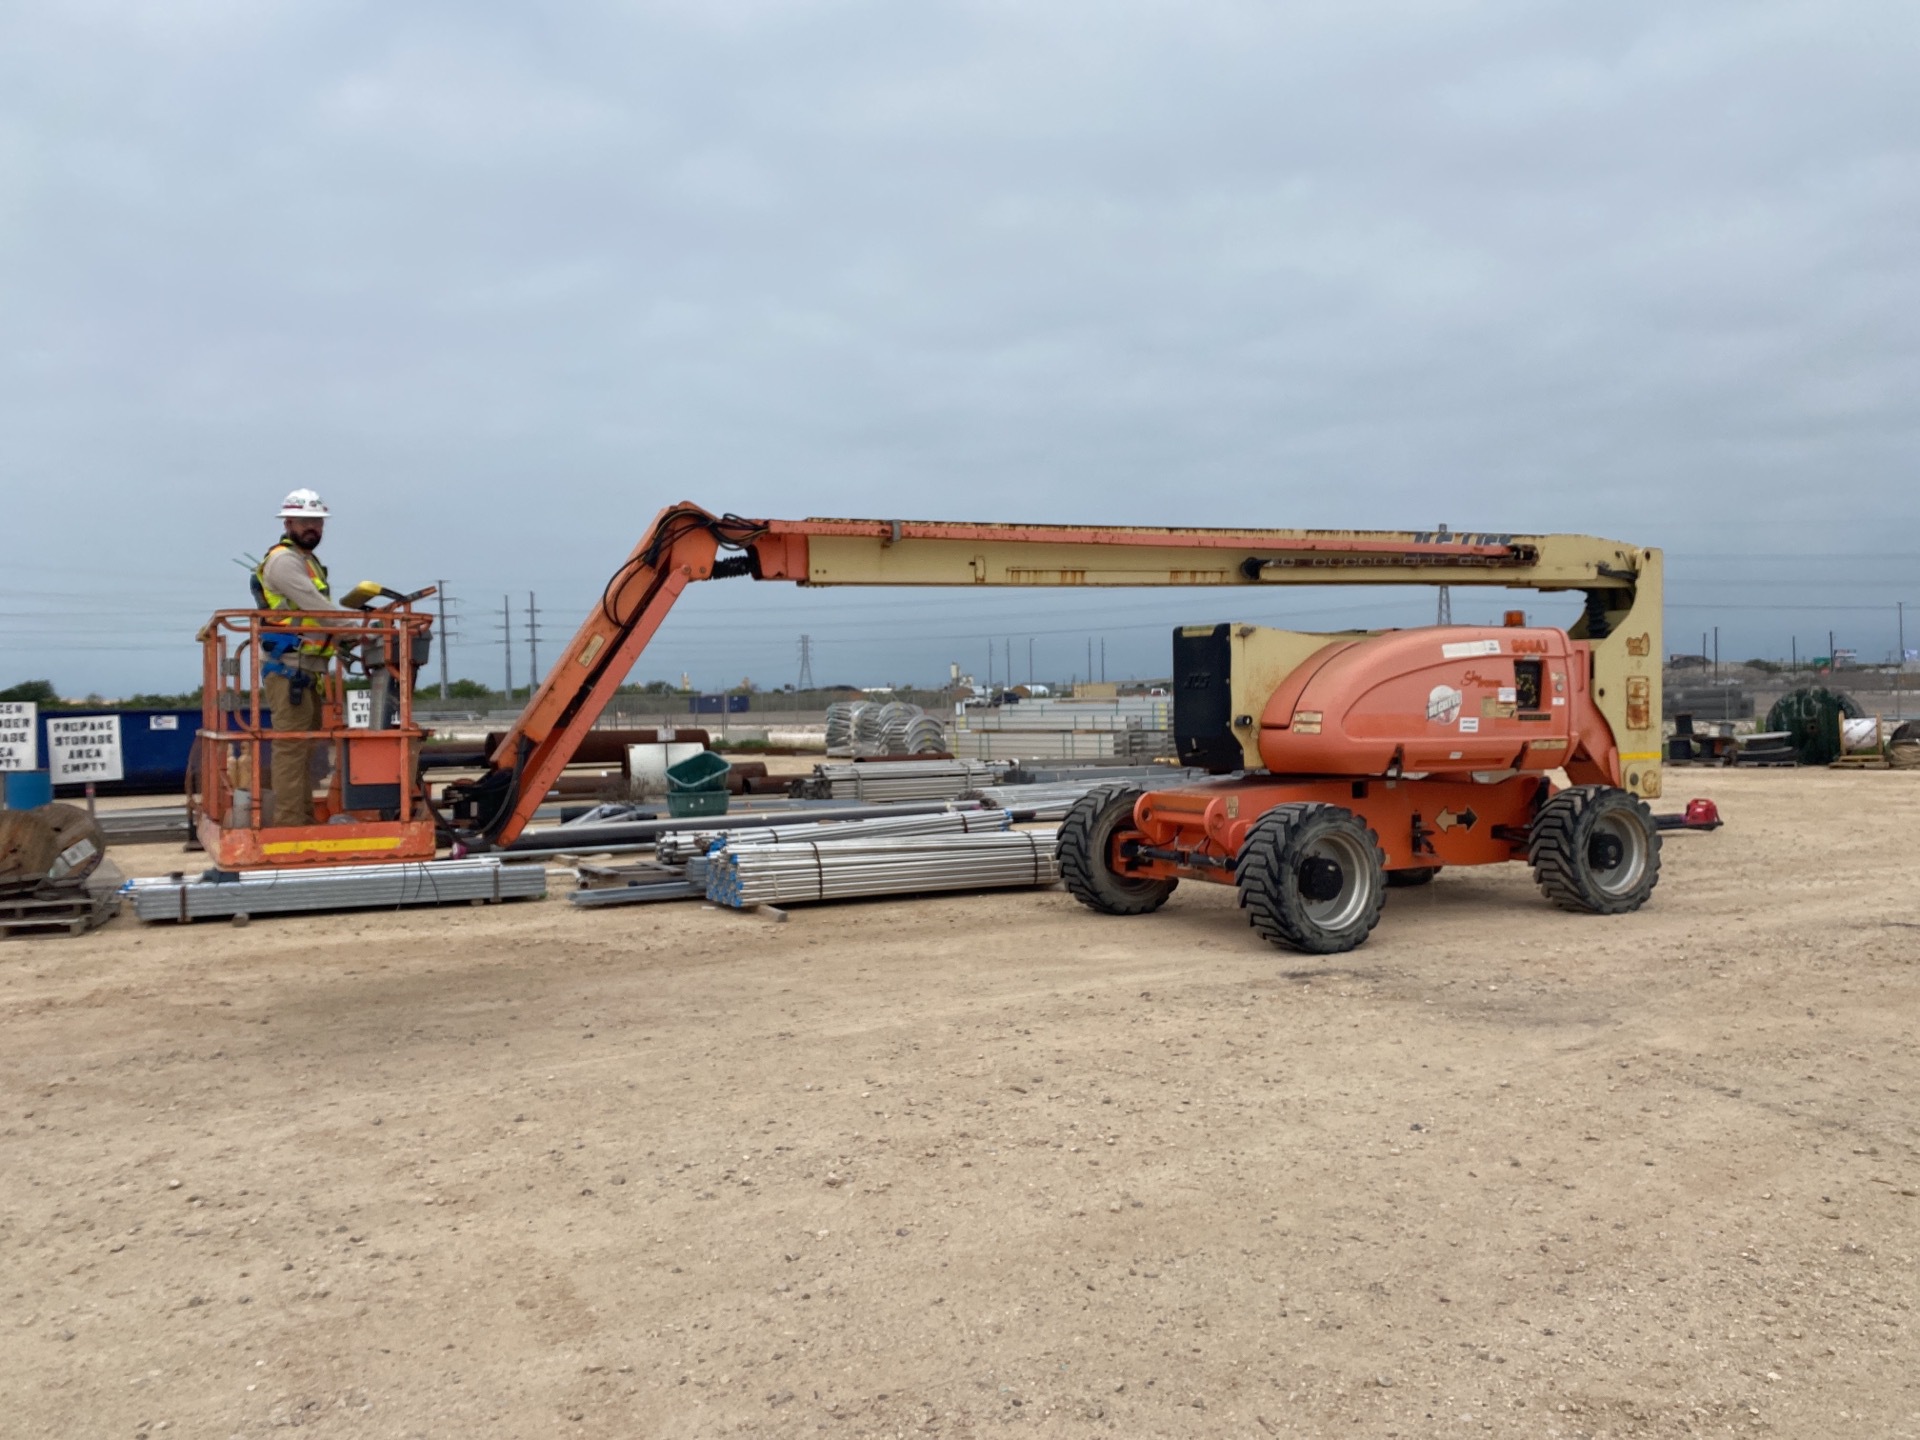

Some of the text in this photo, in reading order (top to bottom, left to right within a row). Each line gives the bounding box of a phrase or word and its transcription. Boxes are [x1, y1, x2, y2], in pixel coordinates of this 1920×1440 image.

[357, 690, 371, 699] OX
[352, 703, 370, 711] CYL
[54, 721, 113, 732] PROPANE
[54, 734, 113, 746] STORAGE
[68, 748, 102, 760] AREA
[62, 762, 106, 774] EMPTY
